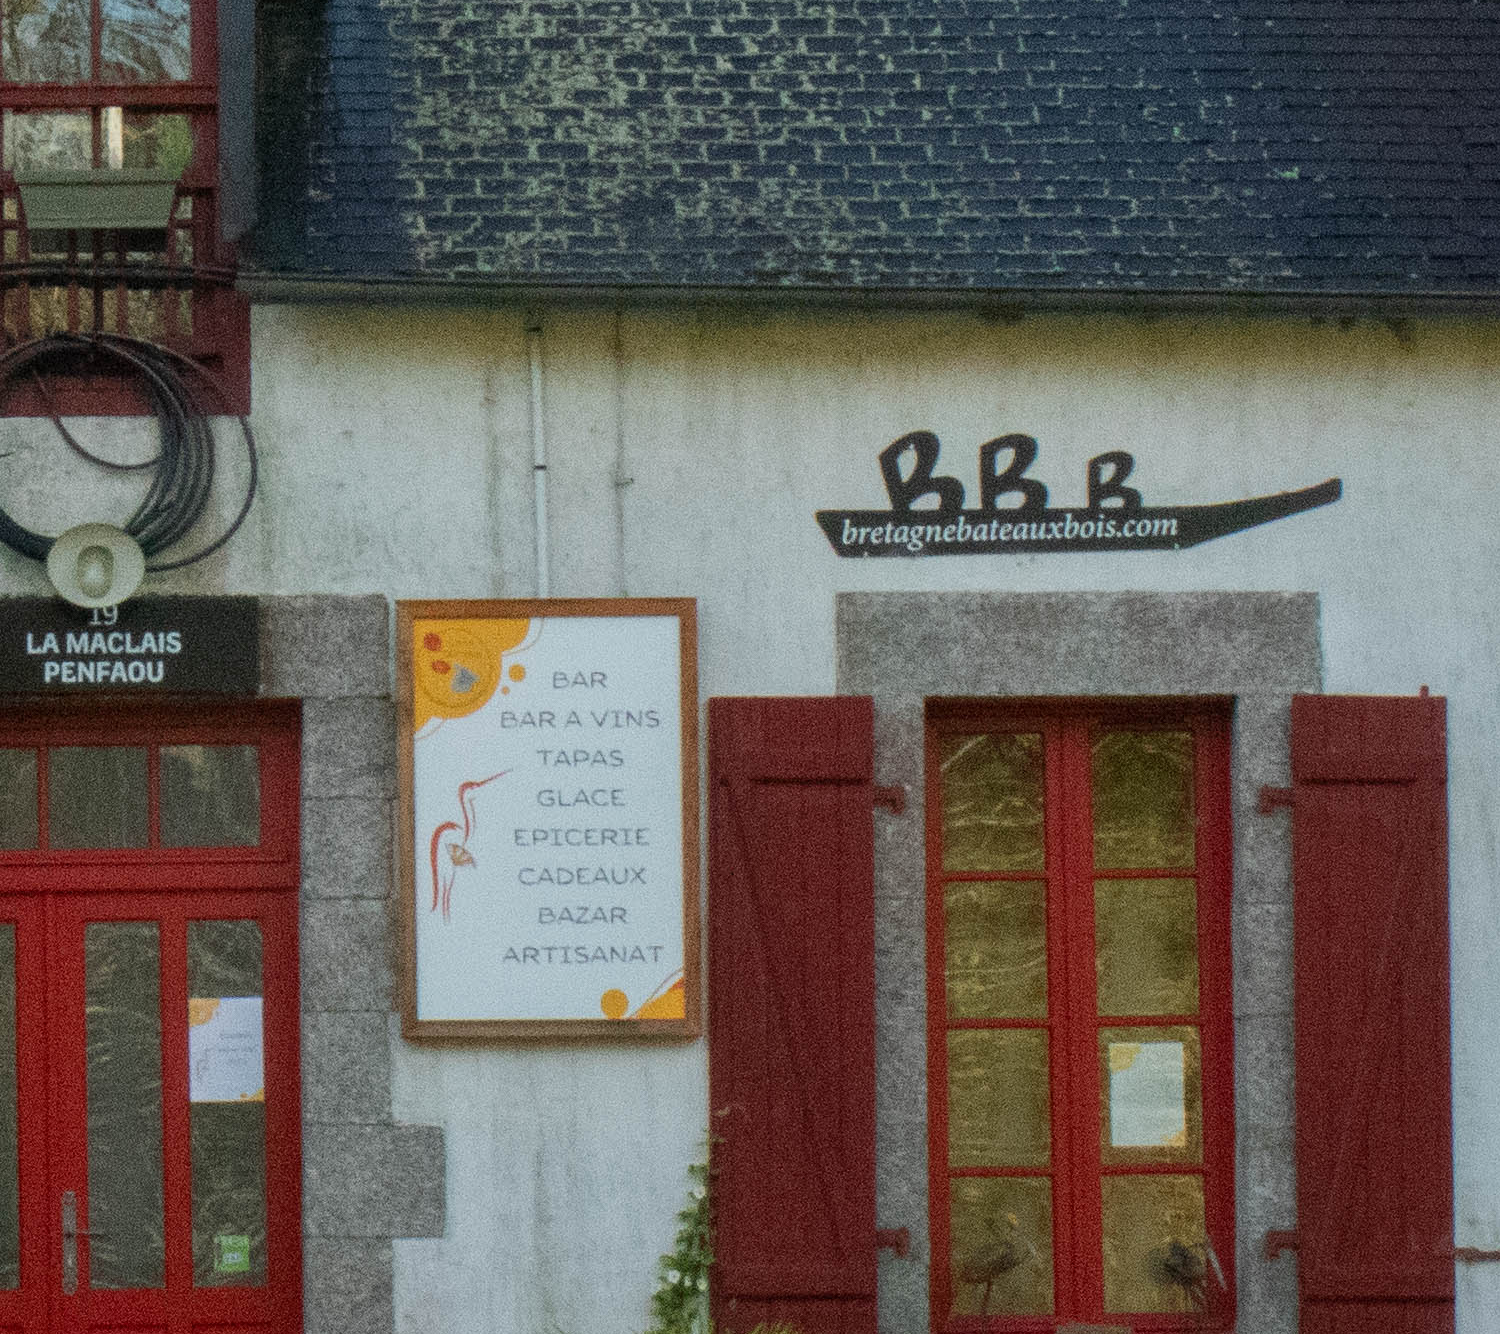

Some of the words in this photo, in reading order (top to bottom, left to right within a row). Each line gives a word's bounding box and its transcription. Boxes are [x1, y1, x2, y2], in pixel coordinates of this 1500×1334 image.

[842, 514, 1179, 551] bretagnebateauxbois.com
[89, 604, 118, 626] 19
[26, 632, 59, 654] LA
[66, 631, 182, 654] MACLAIS
[44, 660, 165, 684] PENFAOU
[552, 671, 608, 690] BAR
[501, 710, 557, 729] BAR
[564, 710, 583, 729] A
[590, 709, 661, 729] VINS
[536, 749, 625, 767] TAPAS
[537, 788, 626, 808] GLACE
[514, 827, 651, 847] EPICERIE
[518, 867, 647, 886] CADEAUX
[538, 906, 628, 925] BAZAR
[502, 945, 665, 965] ARTISANAT
